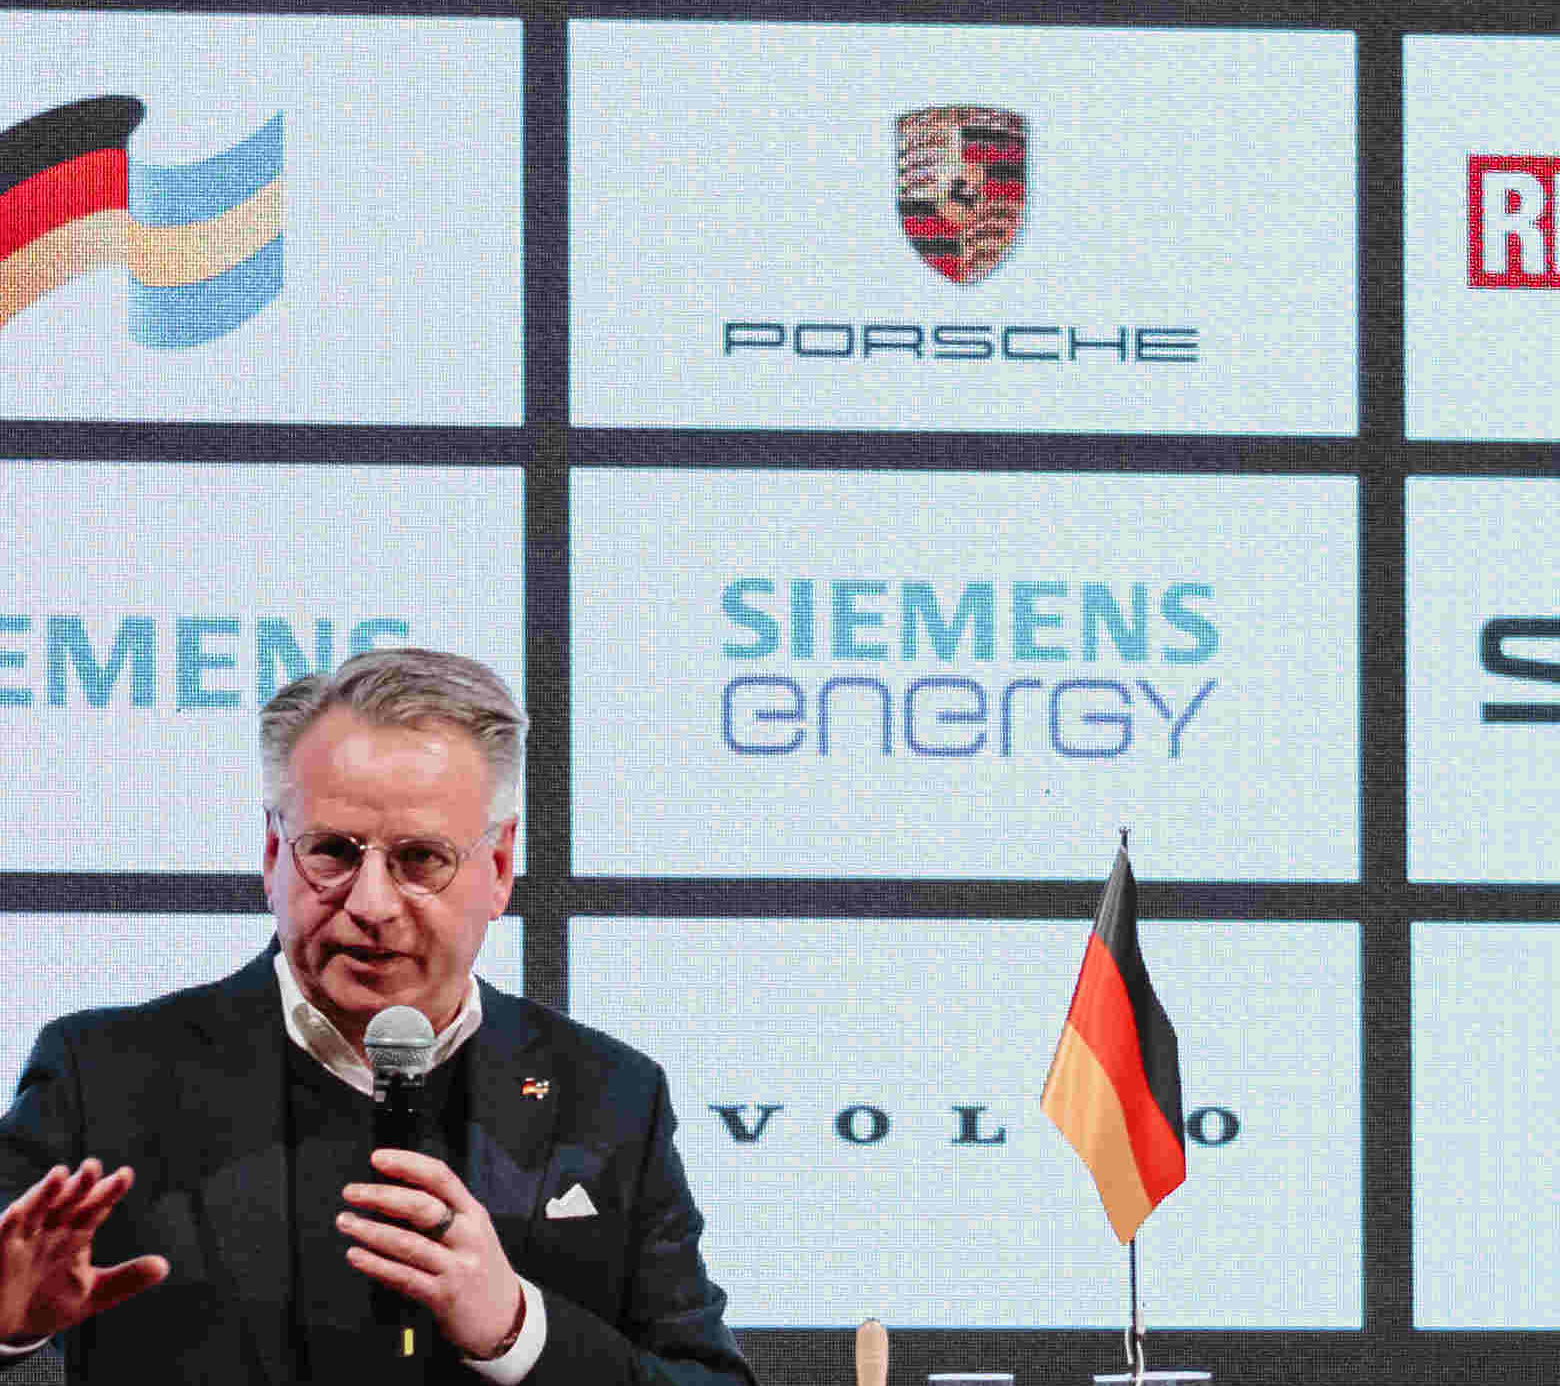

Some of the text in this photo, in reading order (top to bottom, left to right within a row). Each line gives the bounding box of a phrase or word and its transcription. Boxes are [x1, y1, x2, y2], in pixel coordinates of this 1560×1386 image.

[723, 321, 1198, 363] PORSCHE
[722, 578, 1219, 664] SIEMENS
[708, 1105, 1242, 1147] VOLO
